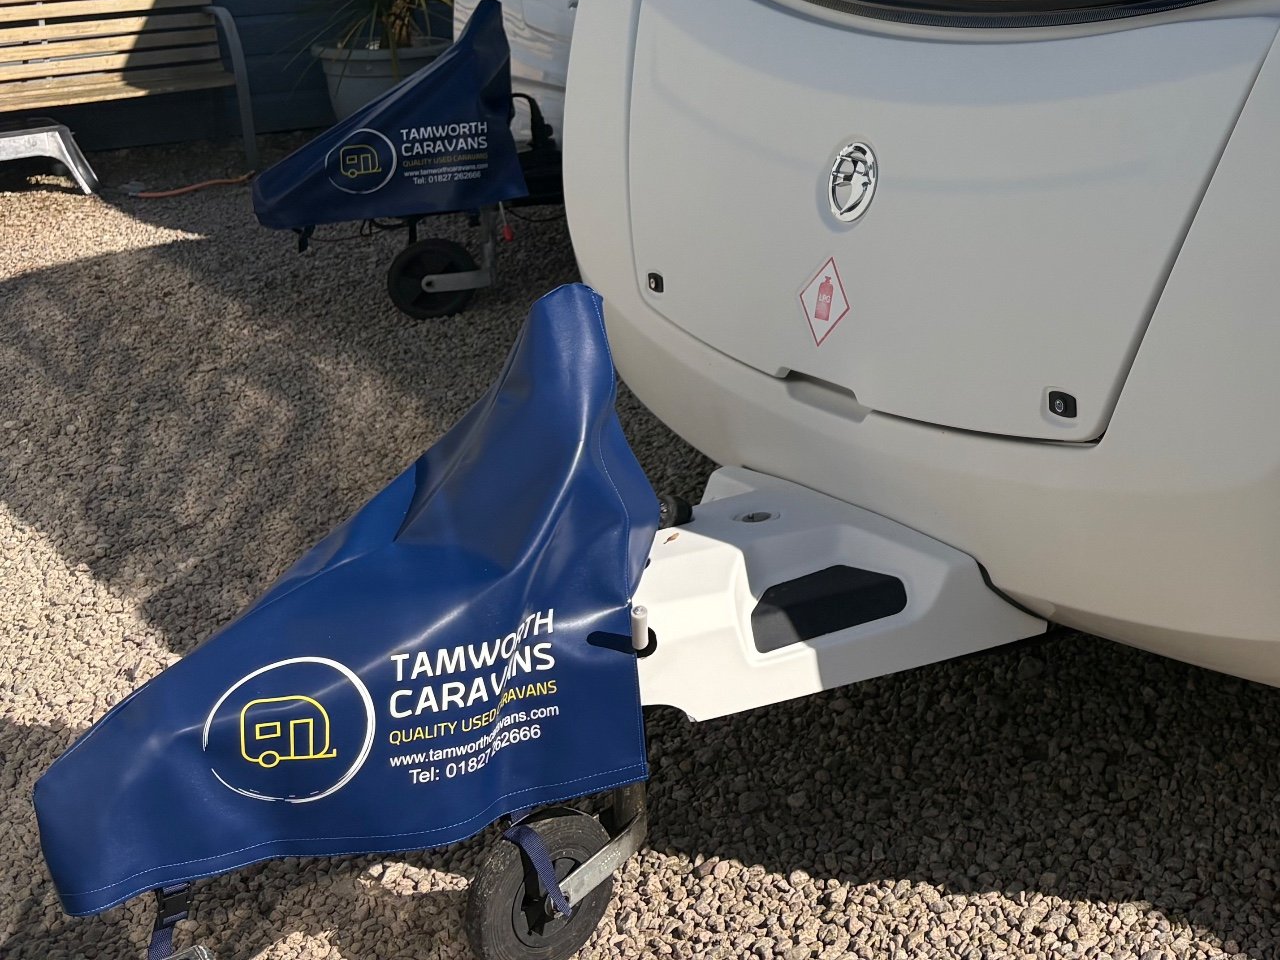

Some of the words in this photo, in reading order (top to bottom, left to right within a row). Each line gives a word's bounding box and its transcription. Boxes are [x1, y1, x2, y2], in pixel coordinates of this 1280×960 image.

[400, 121, 488, 141] TAMWORTH
[401, 136, 488, 156] CARAVANS
[390, 608, 554, 682] TAMWORTH
[389, 642, 556, 719] CARAVANS
[389, 721, 458, 746] QUALITY
[461, 711, 497, 732] USED
[408, 767, 440, 785] Tel:
[445, 748, 491, 779] 01827
